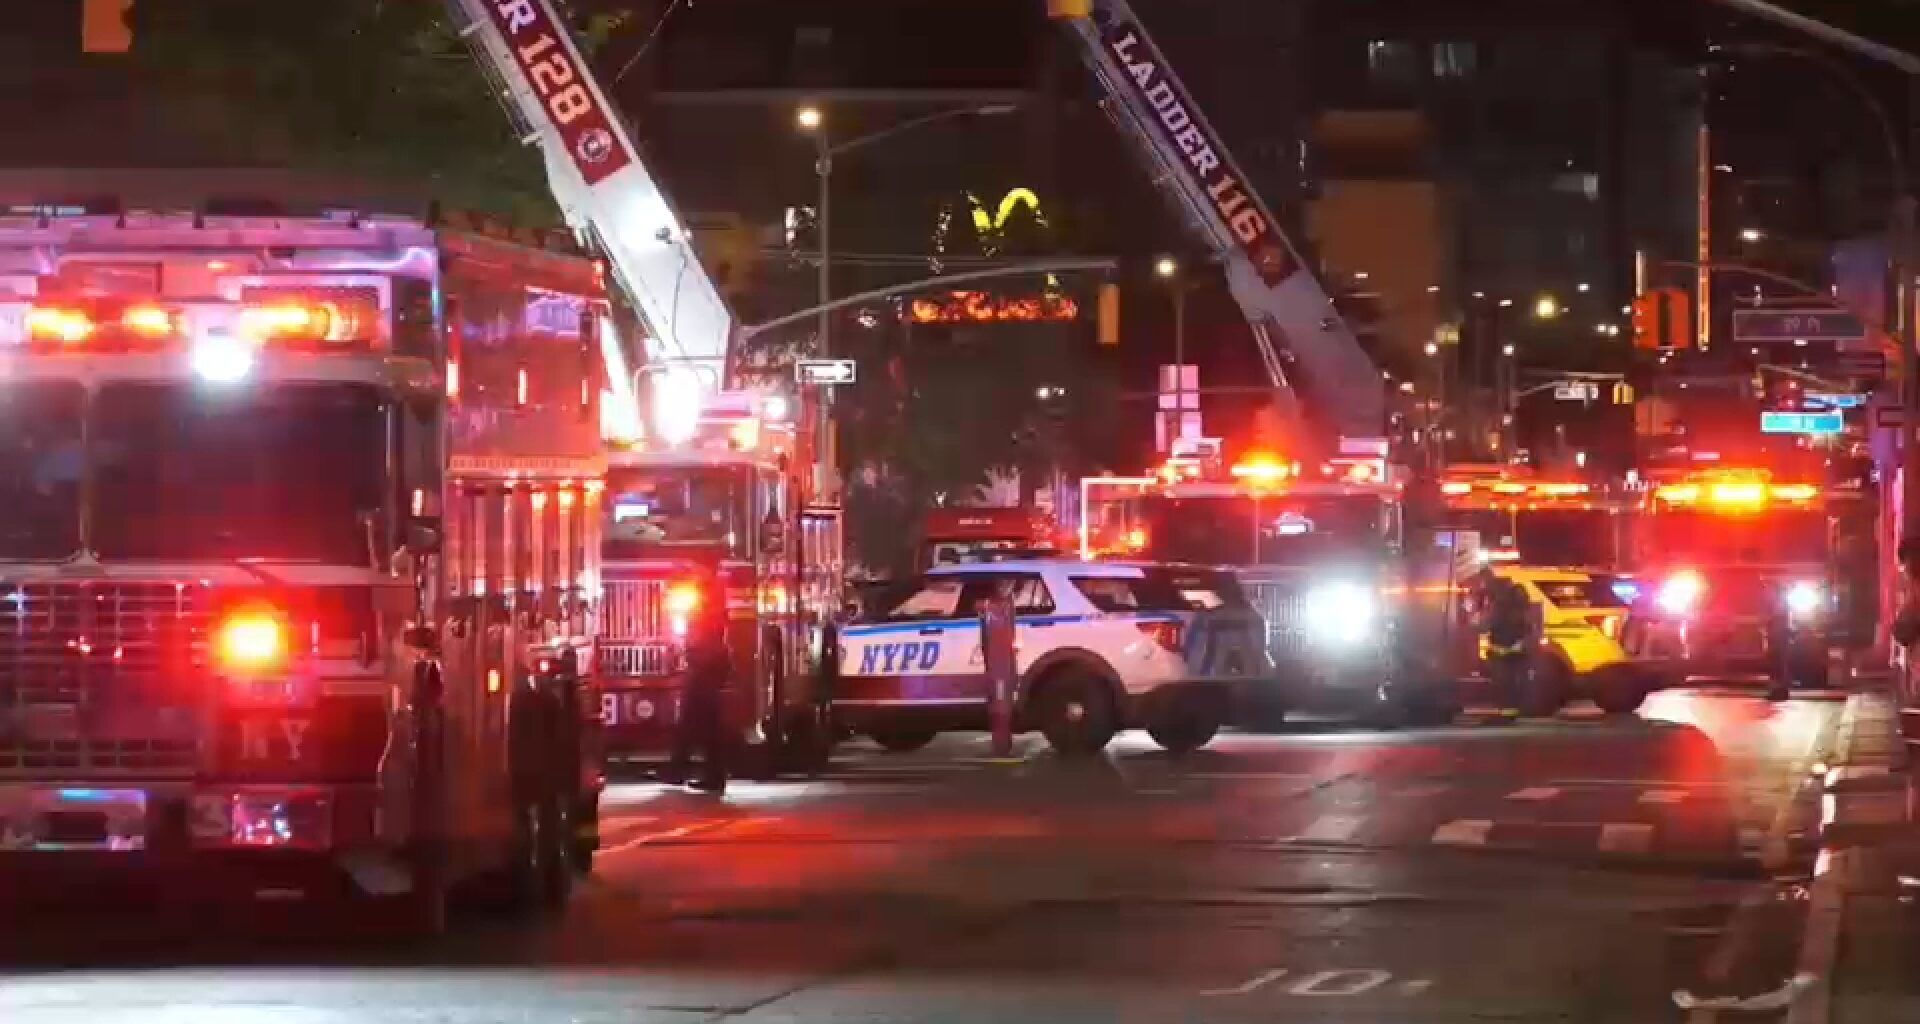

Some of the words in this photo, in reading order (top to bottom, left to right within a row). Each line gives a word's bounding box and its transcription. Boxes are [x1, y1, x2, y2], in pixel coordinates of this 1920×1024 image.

[518, 34, 592, 125] 128
[1112, 31, 1220, 177] LADDER
[1208, 174, 1266, 244] 116
[859, 641, 941, 674] NYPD
